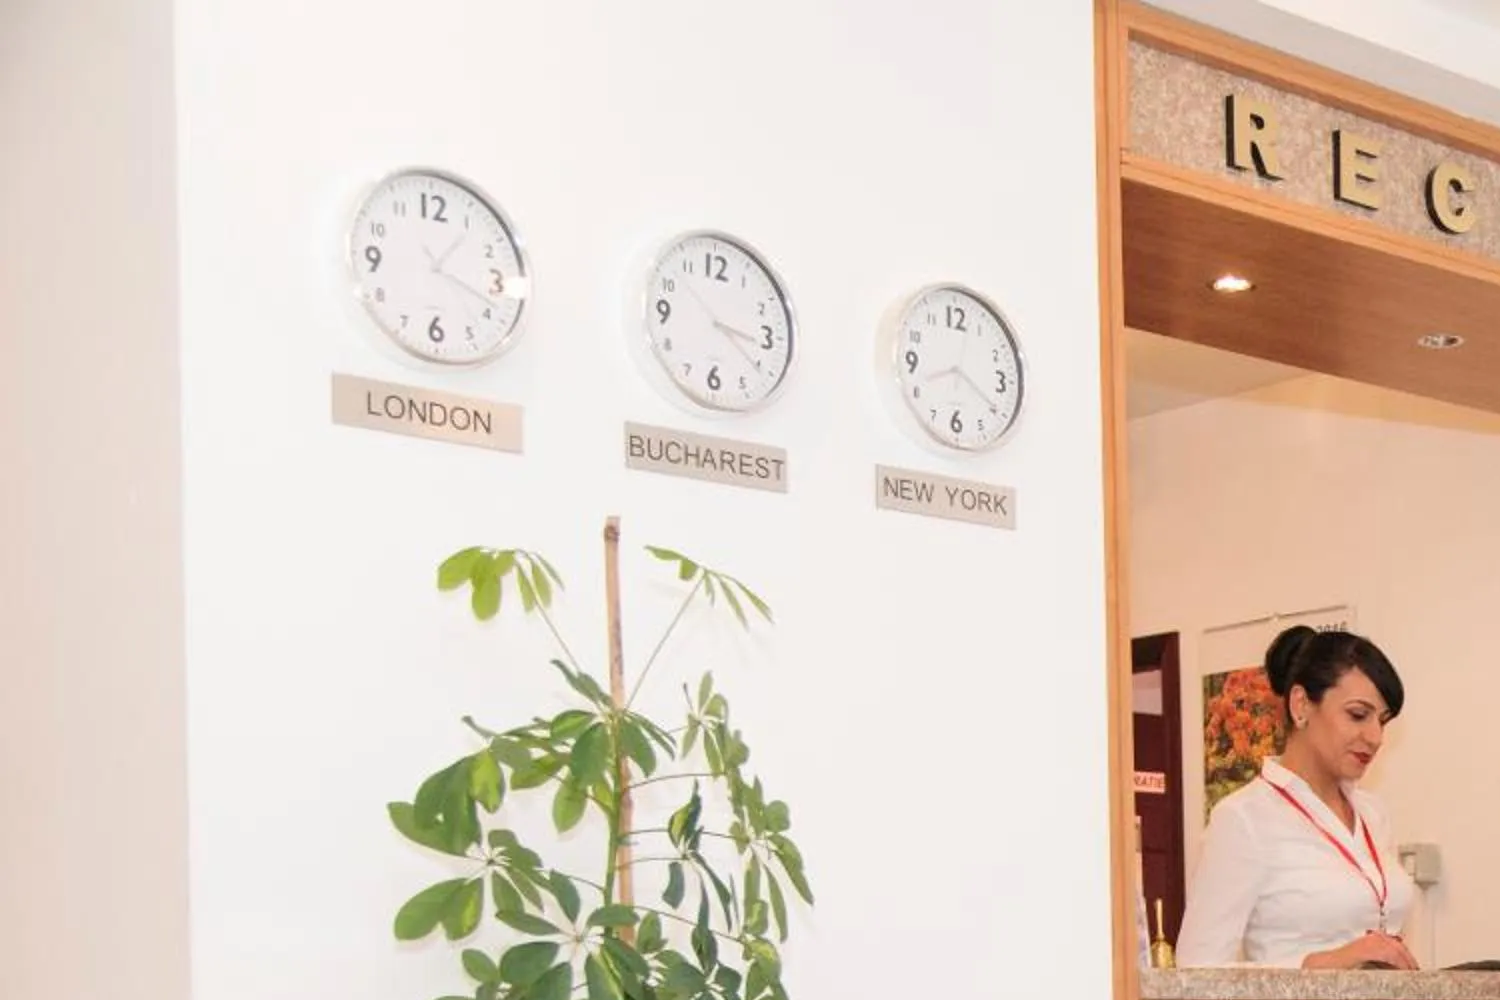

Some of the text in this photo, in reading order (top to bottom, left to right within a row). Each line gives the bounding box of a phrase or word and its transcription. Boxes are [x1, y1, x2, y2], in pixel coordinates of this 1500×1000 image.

[393, 200, 406, 217] 11
[421, 192, 448, 223] 12
[371, 222, 385, 238] 10
[364, 245, 382, 273] 9
[485, 244, 495, 259] 2
[683, 259, 693, 274] 11
[705, 252, 729, 282] 12
[488, 268, 504, 296] 3
[662, 277, 675, 293] 10
[656, 299, 671, 324] 9
[757, 302, 765, 316] 2
[946, 305, 967, 332] 12
[428, 316, 445, 343] 6
[465, 326, 475, 341] 5
[760, 325, 773, 350] 3
[909, 330, 921, 344] 10
[683, 362, 692, 377] 7
[905, 350, 919, 374] 9
[707, 365, 721, 391] 6
[738, 375, 747, 389] 5
[995, 370, 1007, 394] 3
[366, 391, 492, 434] LONDON
[950, 410, 963, 433] 6
[628, 434, 785, 481] BUCHAREST
[883, 476, 1007, 516] NEW YORK
